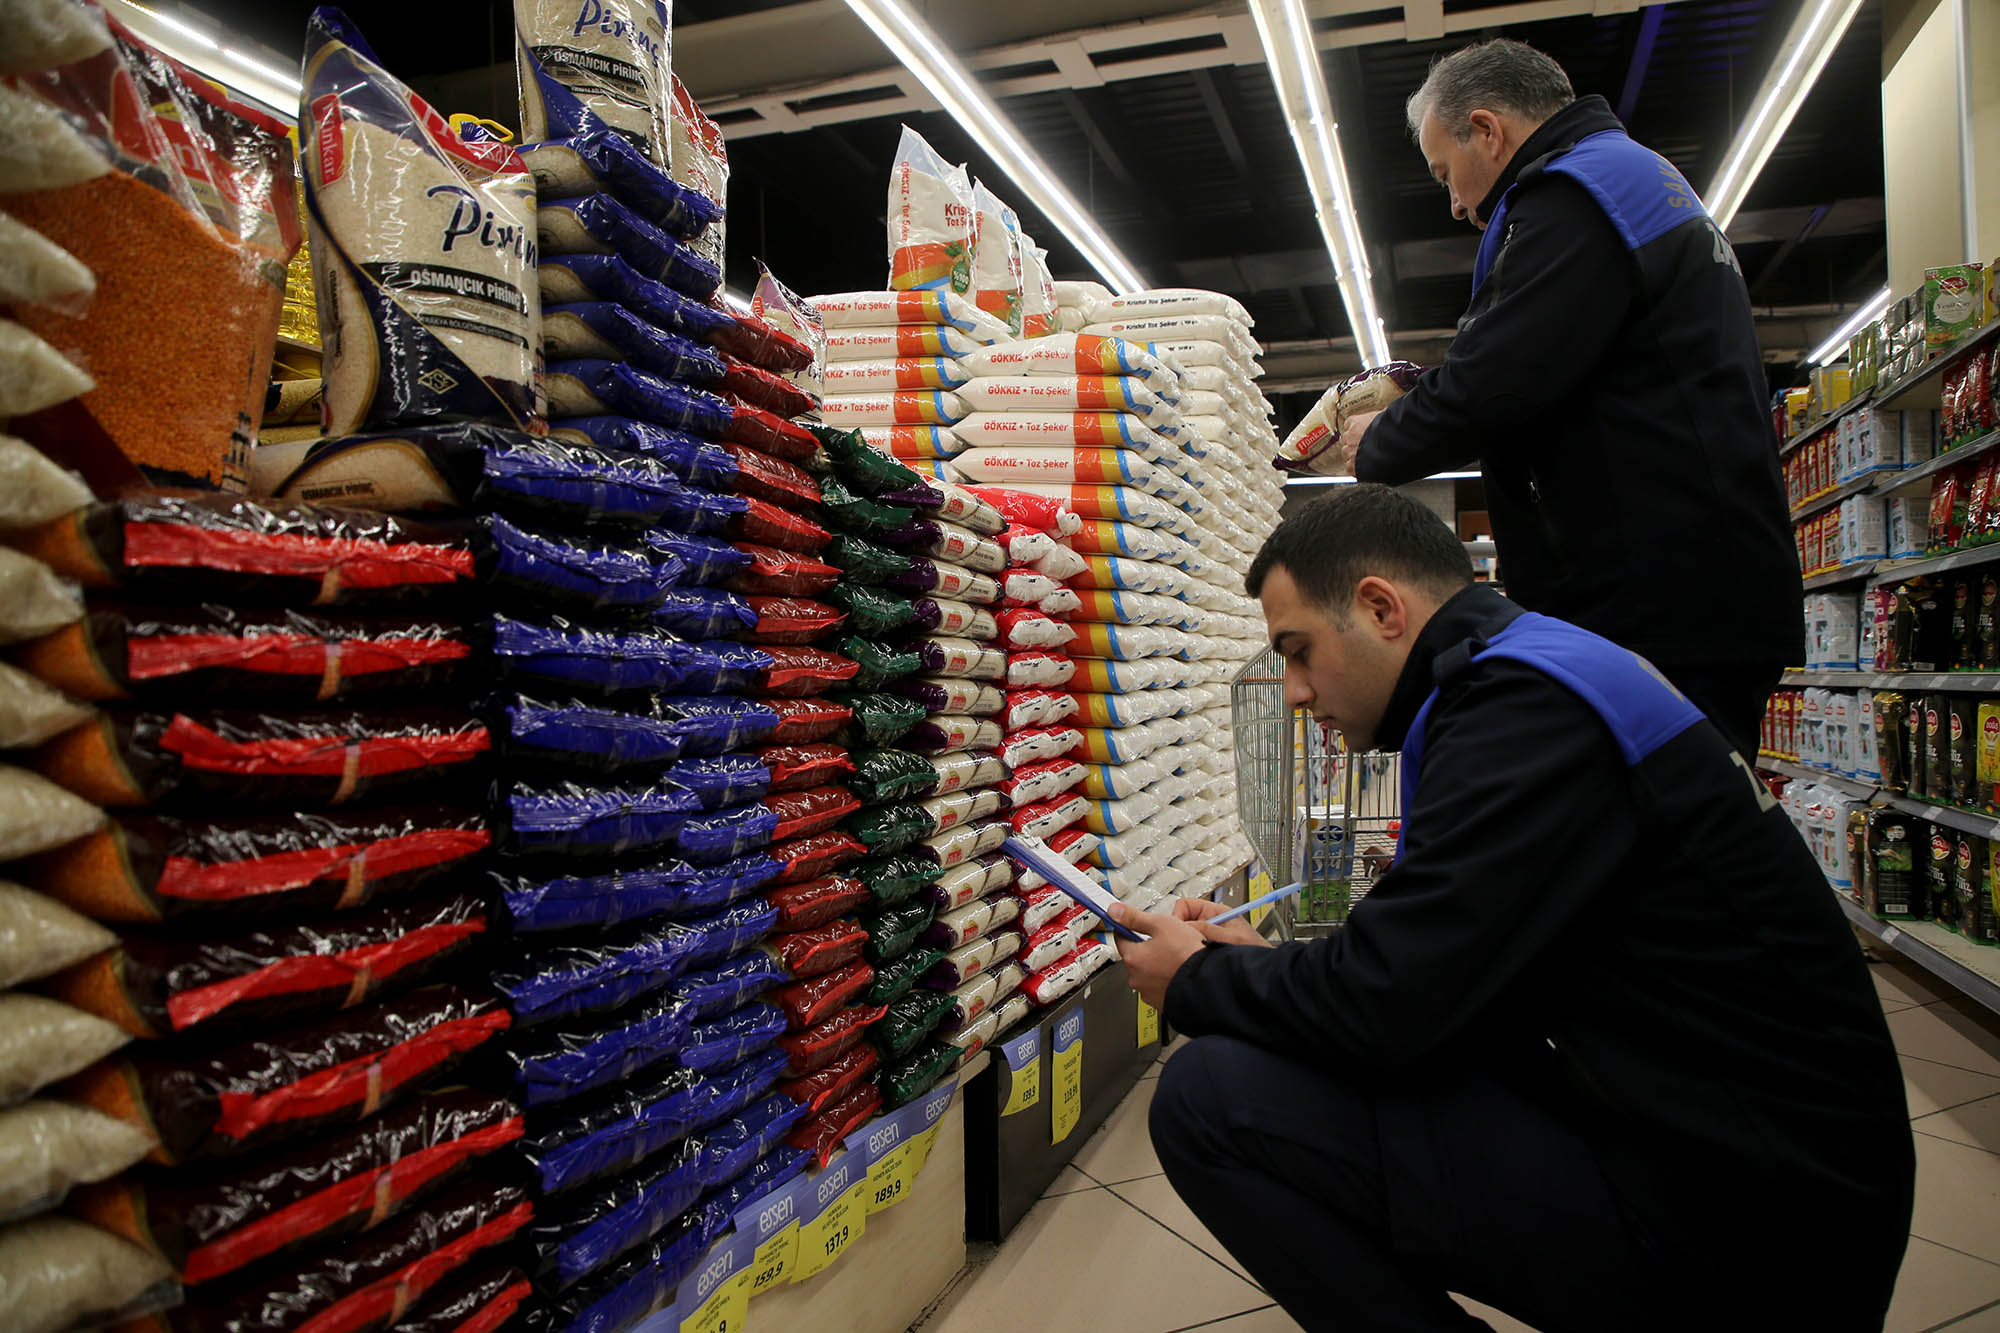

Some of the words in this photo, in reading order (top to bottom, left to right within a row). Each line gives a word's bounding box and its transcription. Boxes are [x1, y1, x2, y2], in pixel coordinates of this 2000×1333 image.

[553, 49, 610, 74] OSMANCIK
[427, 185, 538, 269] Pirin
[945, 217, 959, 227] Toz
[410, 270, 485, 297] OSMANCIK
[486, 282, 521, 311] PİRİNÇ
[854, 302, 867, 311] Toz
[868, 301, 892, 312] Şeker
[853, 336, 867, 345] Toz
[868, 335, 892, 346] Şeker
[852, 369, 866, 378] Toz
[867, 367, 891, 379] Şeker
[988, 385, 1021, 395] GÖKKIZ
[1030, 386, 1044, 396] Toz
[1046, 386, 1072, 397] Şeker
[851, 403, 864, 412] Toz
[865, 402, 889, 413] Şeker
[984, 420, 1017, 431] GÖKKIZ
[1026, 422, 1041, 431] Toz
[1042, 421, 1068, 433] Şeker
[984, 456, 1017, 467] GÖKKIZ
[1026, 458, 1041, 468] Toz
[1042, 458, 1069, 470] Şeker
[875, 1179, 902, 1204] 189,9
[824, 1225, 849, 1257] 137,9
[753, 1260, 784, 1289] 159,9
